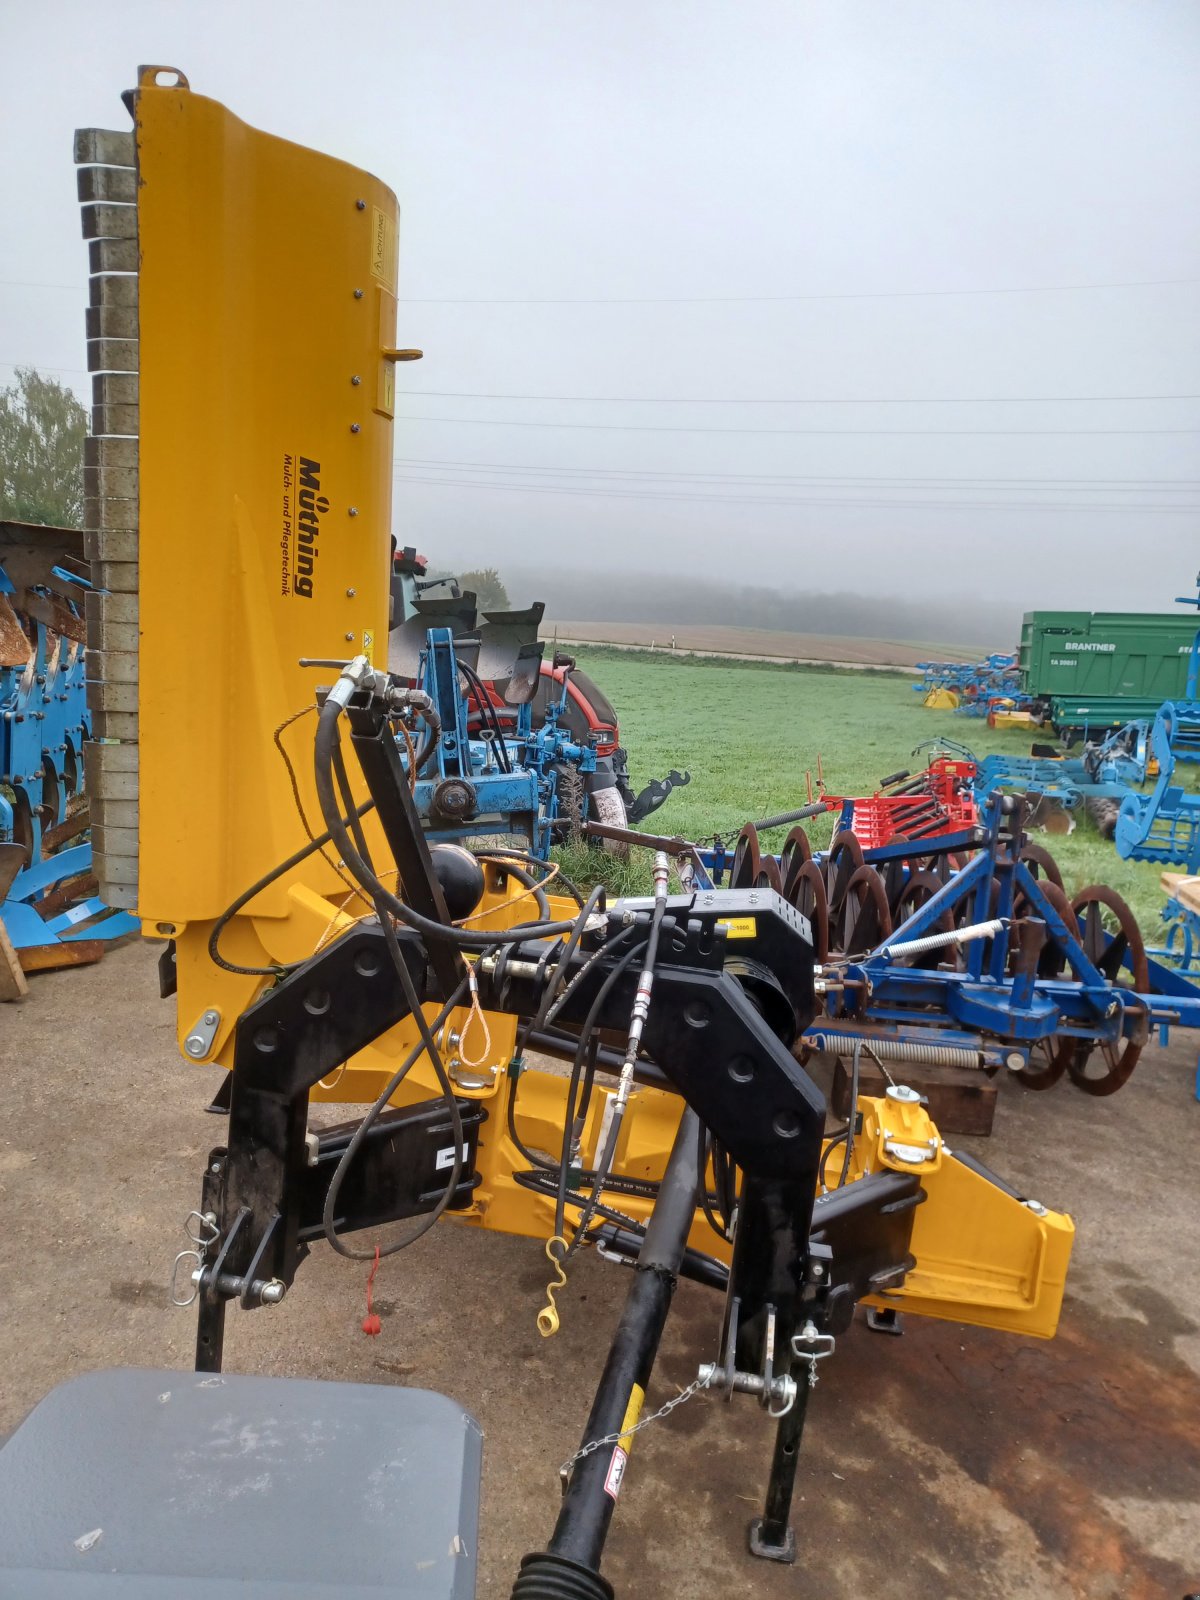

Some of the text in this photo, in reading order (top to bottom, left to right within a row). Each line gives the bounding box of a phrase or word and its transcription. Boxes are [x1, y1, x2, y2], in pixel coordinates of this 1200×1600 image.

[280, 453, 293, 597] Mulch- und Pflegetechnik
[294, 456, 330, 598] Müthing
[1064, 642, 1116, 652] BRANTNER
